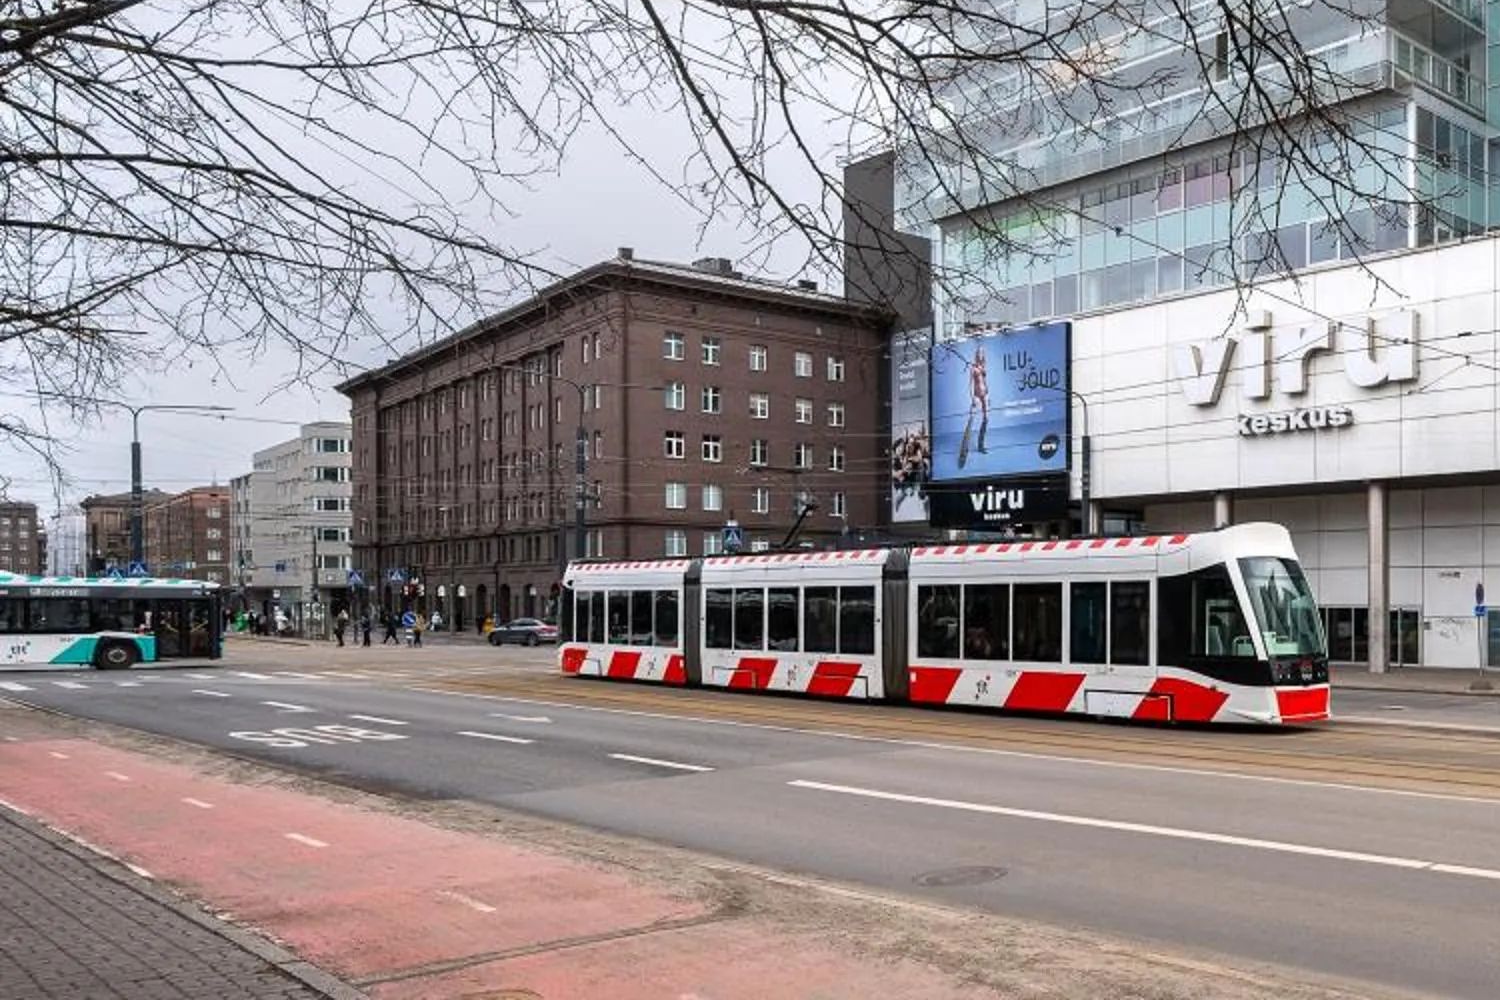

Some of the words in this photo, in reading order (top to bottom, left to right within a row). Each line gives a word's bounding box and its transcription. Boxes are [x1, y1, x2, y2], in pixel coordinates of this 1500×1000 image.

[1178, 309, 1420, 406] viru
[1239, 407, 1354, 437] keskus
[970, 485, 1024, 511] viru
[228, 724, 411, 747] BUS
